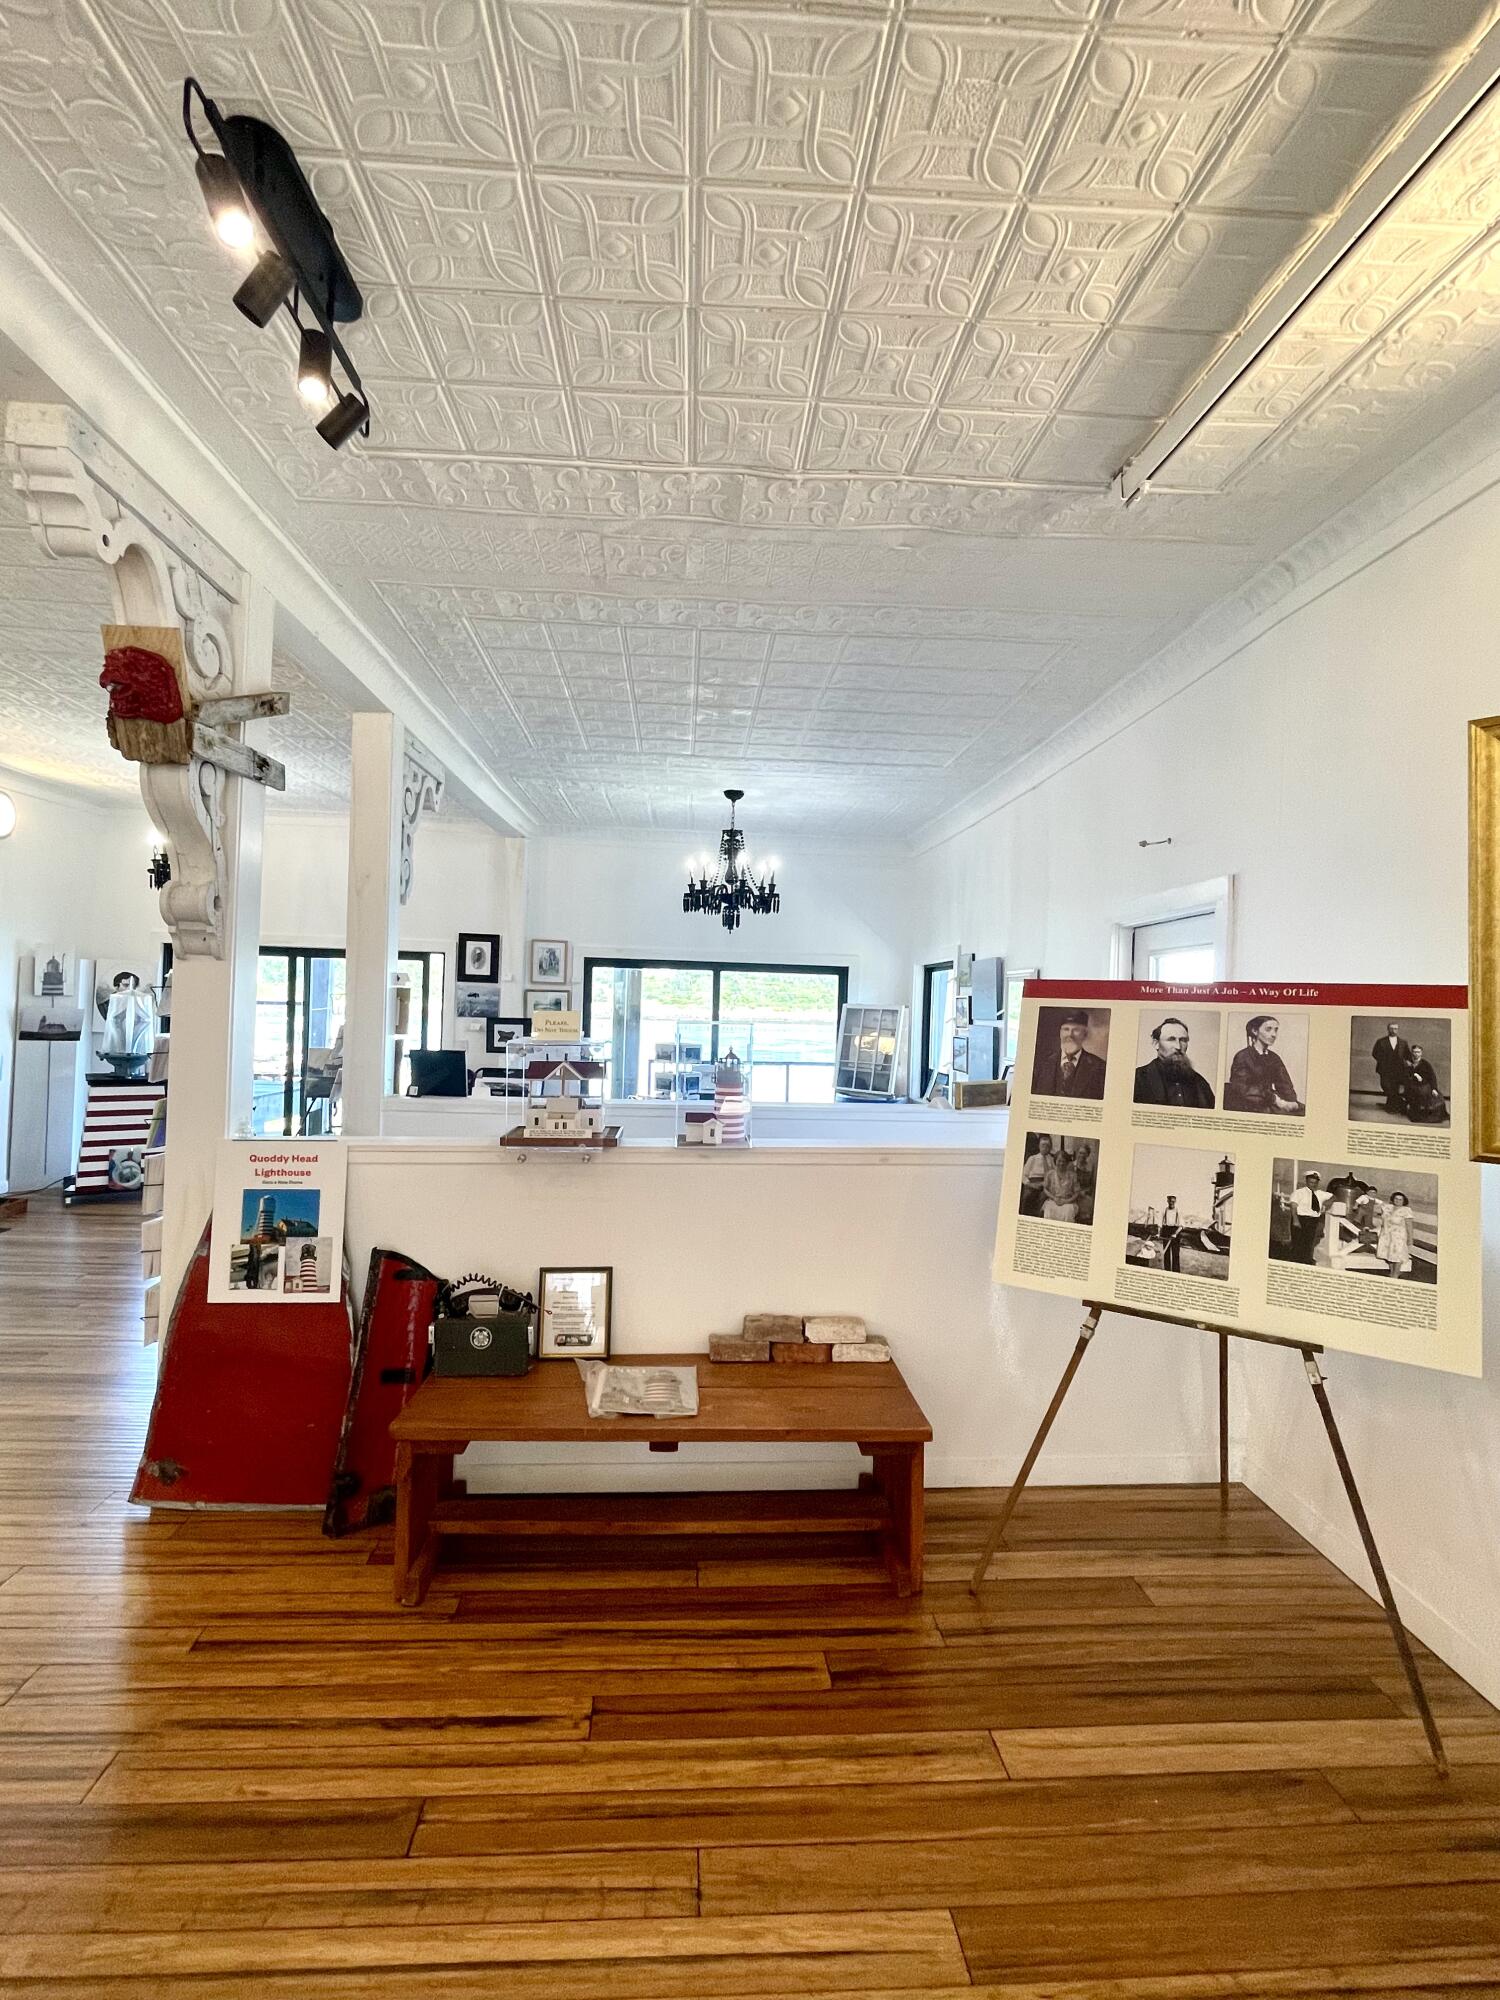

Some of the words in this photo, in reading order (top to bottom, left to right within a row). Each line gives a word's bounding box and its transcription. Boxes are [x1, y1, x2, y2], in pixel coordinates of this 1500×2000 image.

[1140, 985, 1164, 994] More
[1166, 985, 1189, 995] Than
[1190, 986, 1210, 995] Just
[1212, 987, 1220, 995] A
[1221, 986, 1239, 996] Job
[1249, 987, 1257, 996] A
[1258, 987, 1280, 998] Way
[1283, 987, 1296, 997] Of
[1299, 988, 1319, 998] Life
[249, 1154, 290, 1164] Quoddy
[291, 1154, 319, 1163] Head
[254, 1168, 312, 1178] Lighthouse
